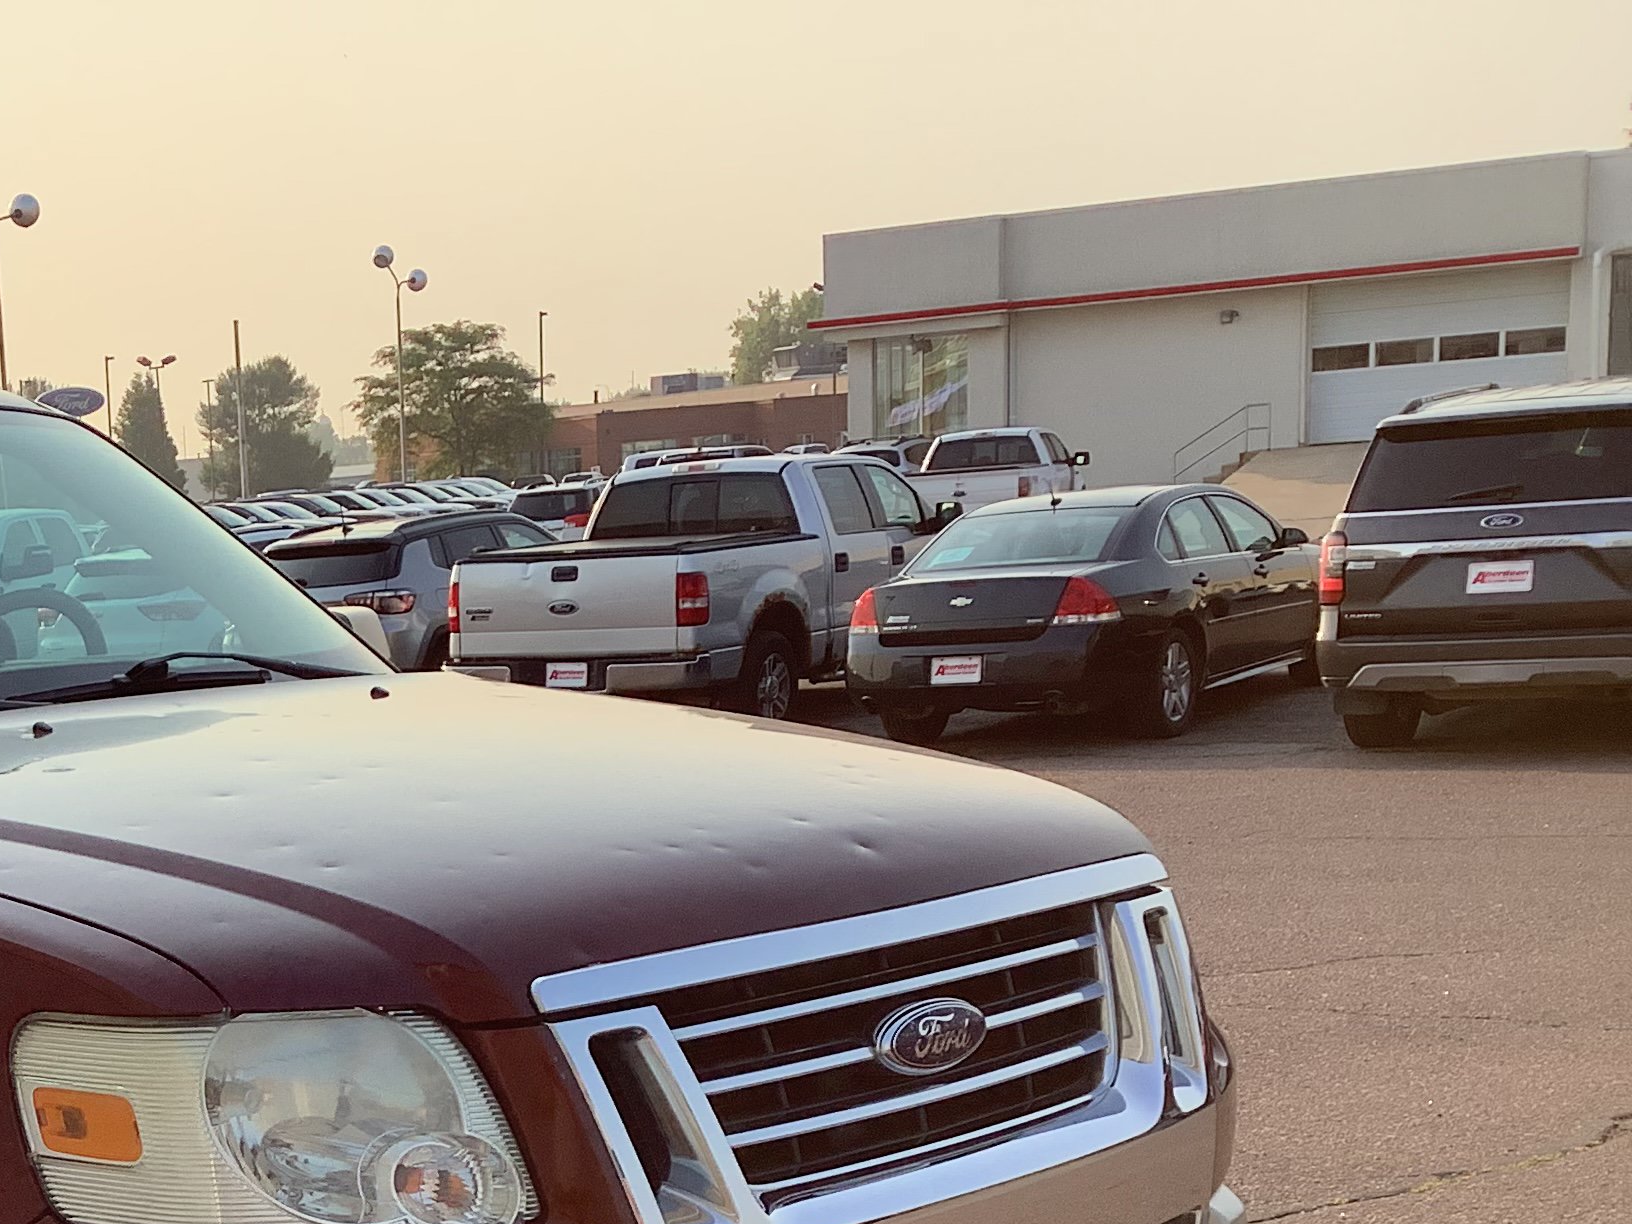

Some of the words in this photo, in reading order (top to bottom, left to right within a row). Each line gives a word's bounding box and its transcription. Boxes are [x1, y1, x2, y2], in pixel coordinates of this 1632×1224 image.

[55, 392, 90, 410] Ford
[1489, 515, 1515, 527] Ford
[915, 1012, 973, 1059] Ford
